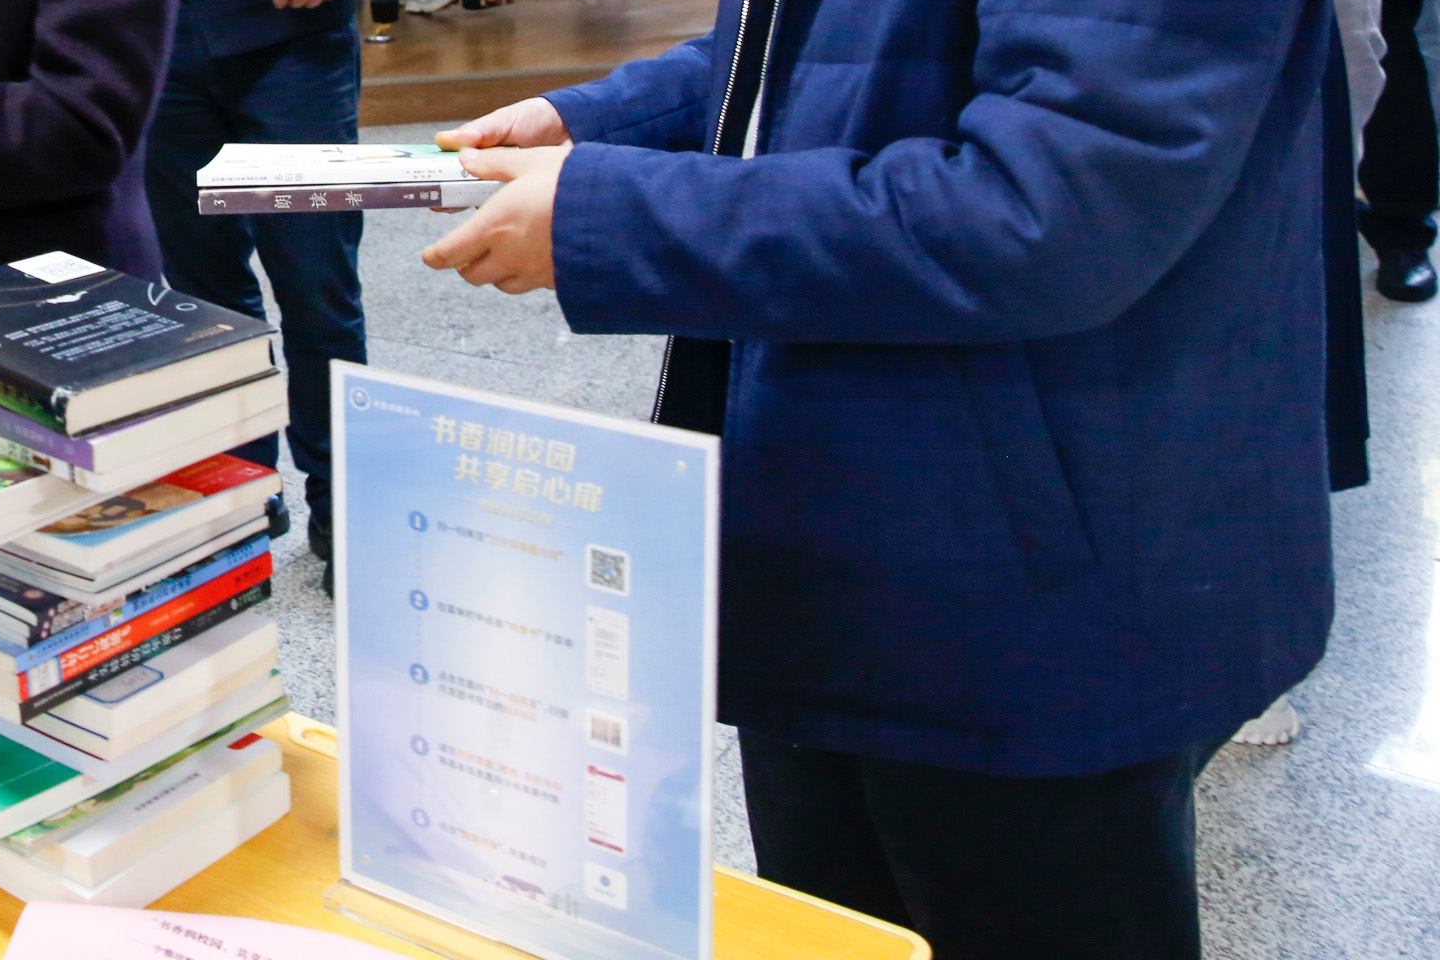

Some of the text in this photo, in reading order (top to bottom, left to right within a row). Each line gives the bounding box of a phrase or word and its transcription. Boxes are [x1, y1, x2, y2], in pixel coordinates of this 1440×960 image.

[213, 191, 364, 209] 3 朗读者
[430, 414, 576, 472] 书香润校园
[454, 454, 603, 512] 共享启心扉
